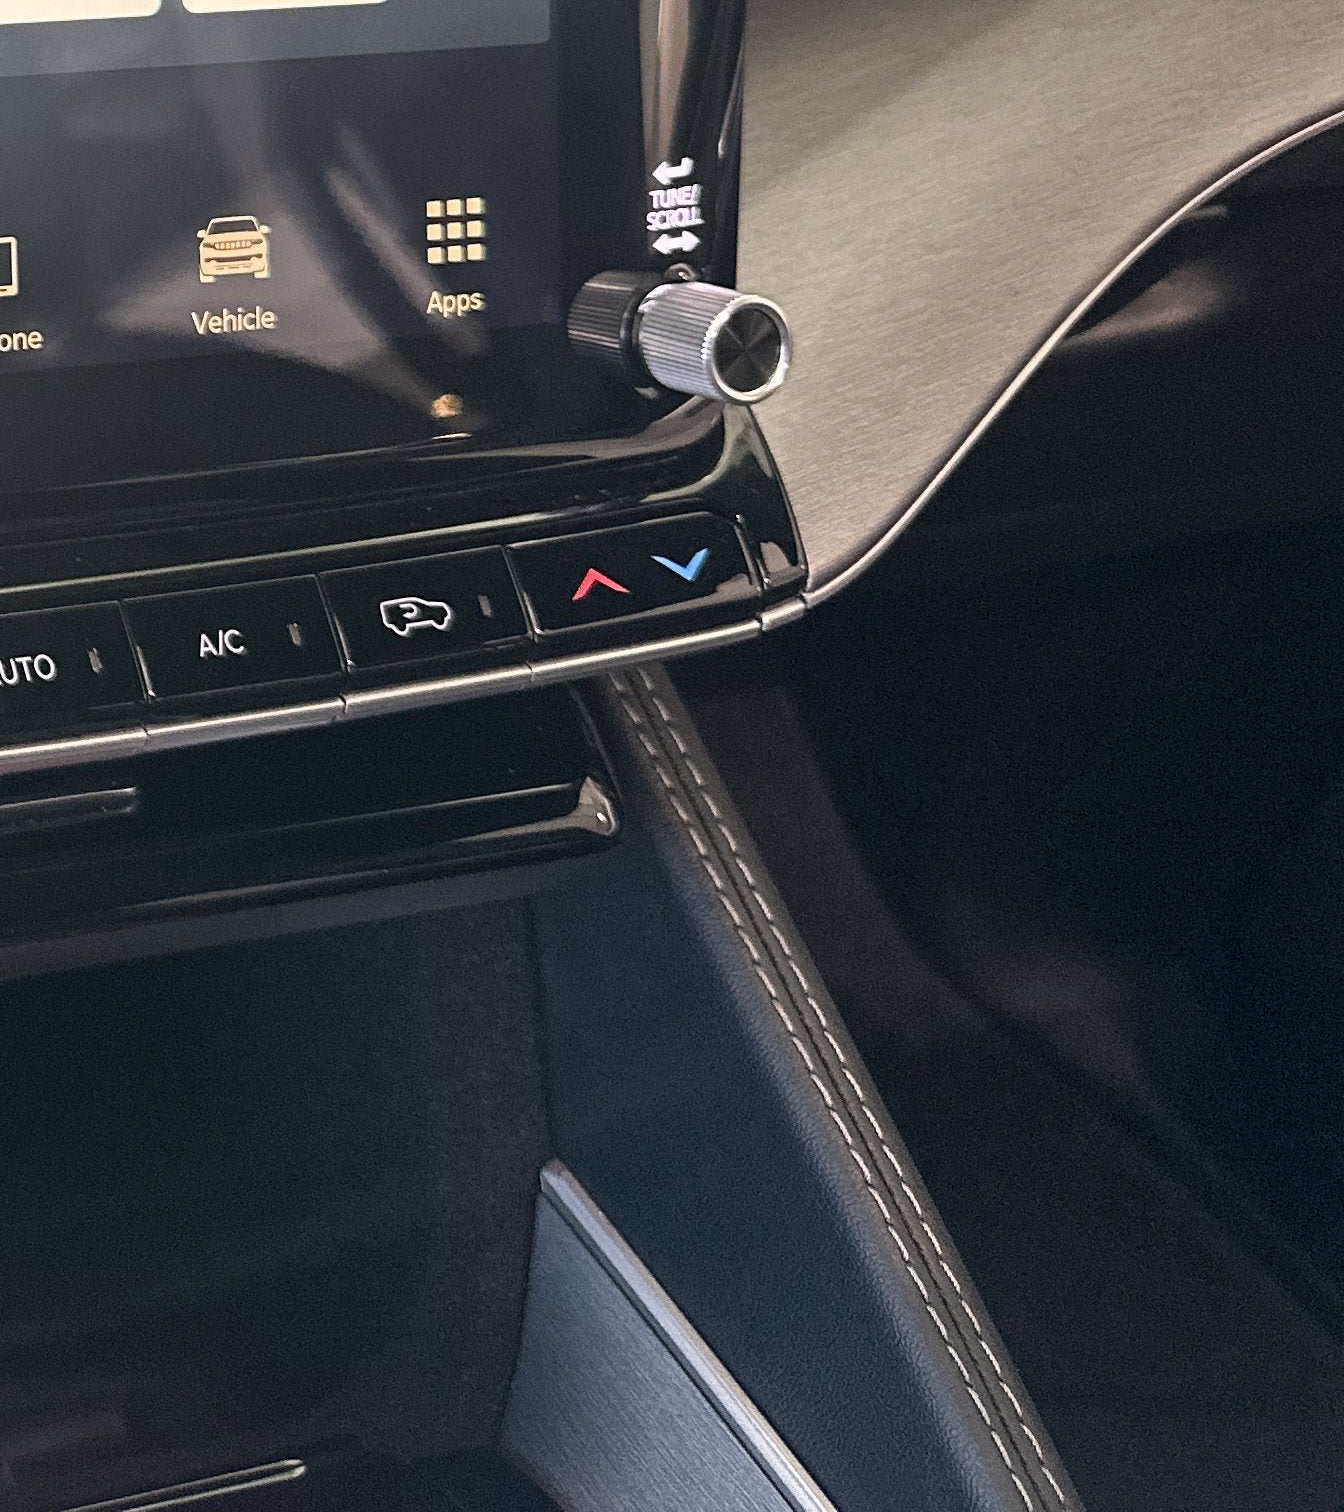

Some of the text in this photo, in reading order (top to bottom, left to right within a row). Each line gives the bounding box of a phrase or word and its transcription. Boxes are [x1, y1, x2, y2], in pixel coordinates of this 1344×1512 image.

[427, 288, 483, 316] Apps
[192, 306, 275, 335] Vehicle
[198, 628, 245, 658] A/C
